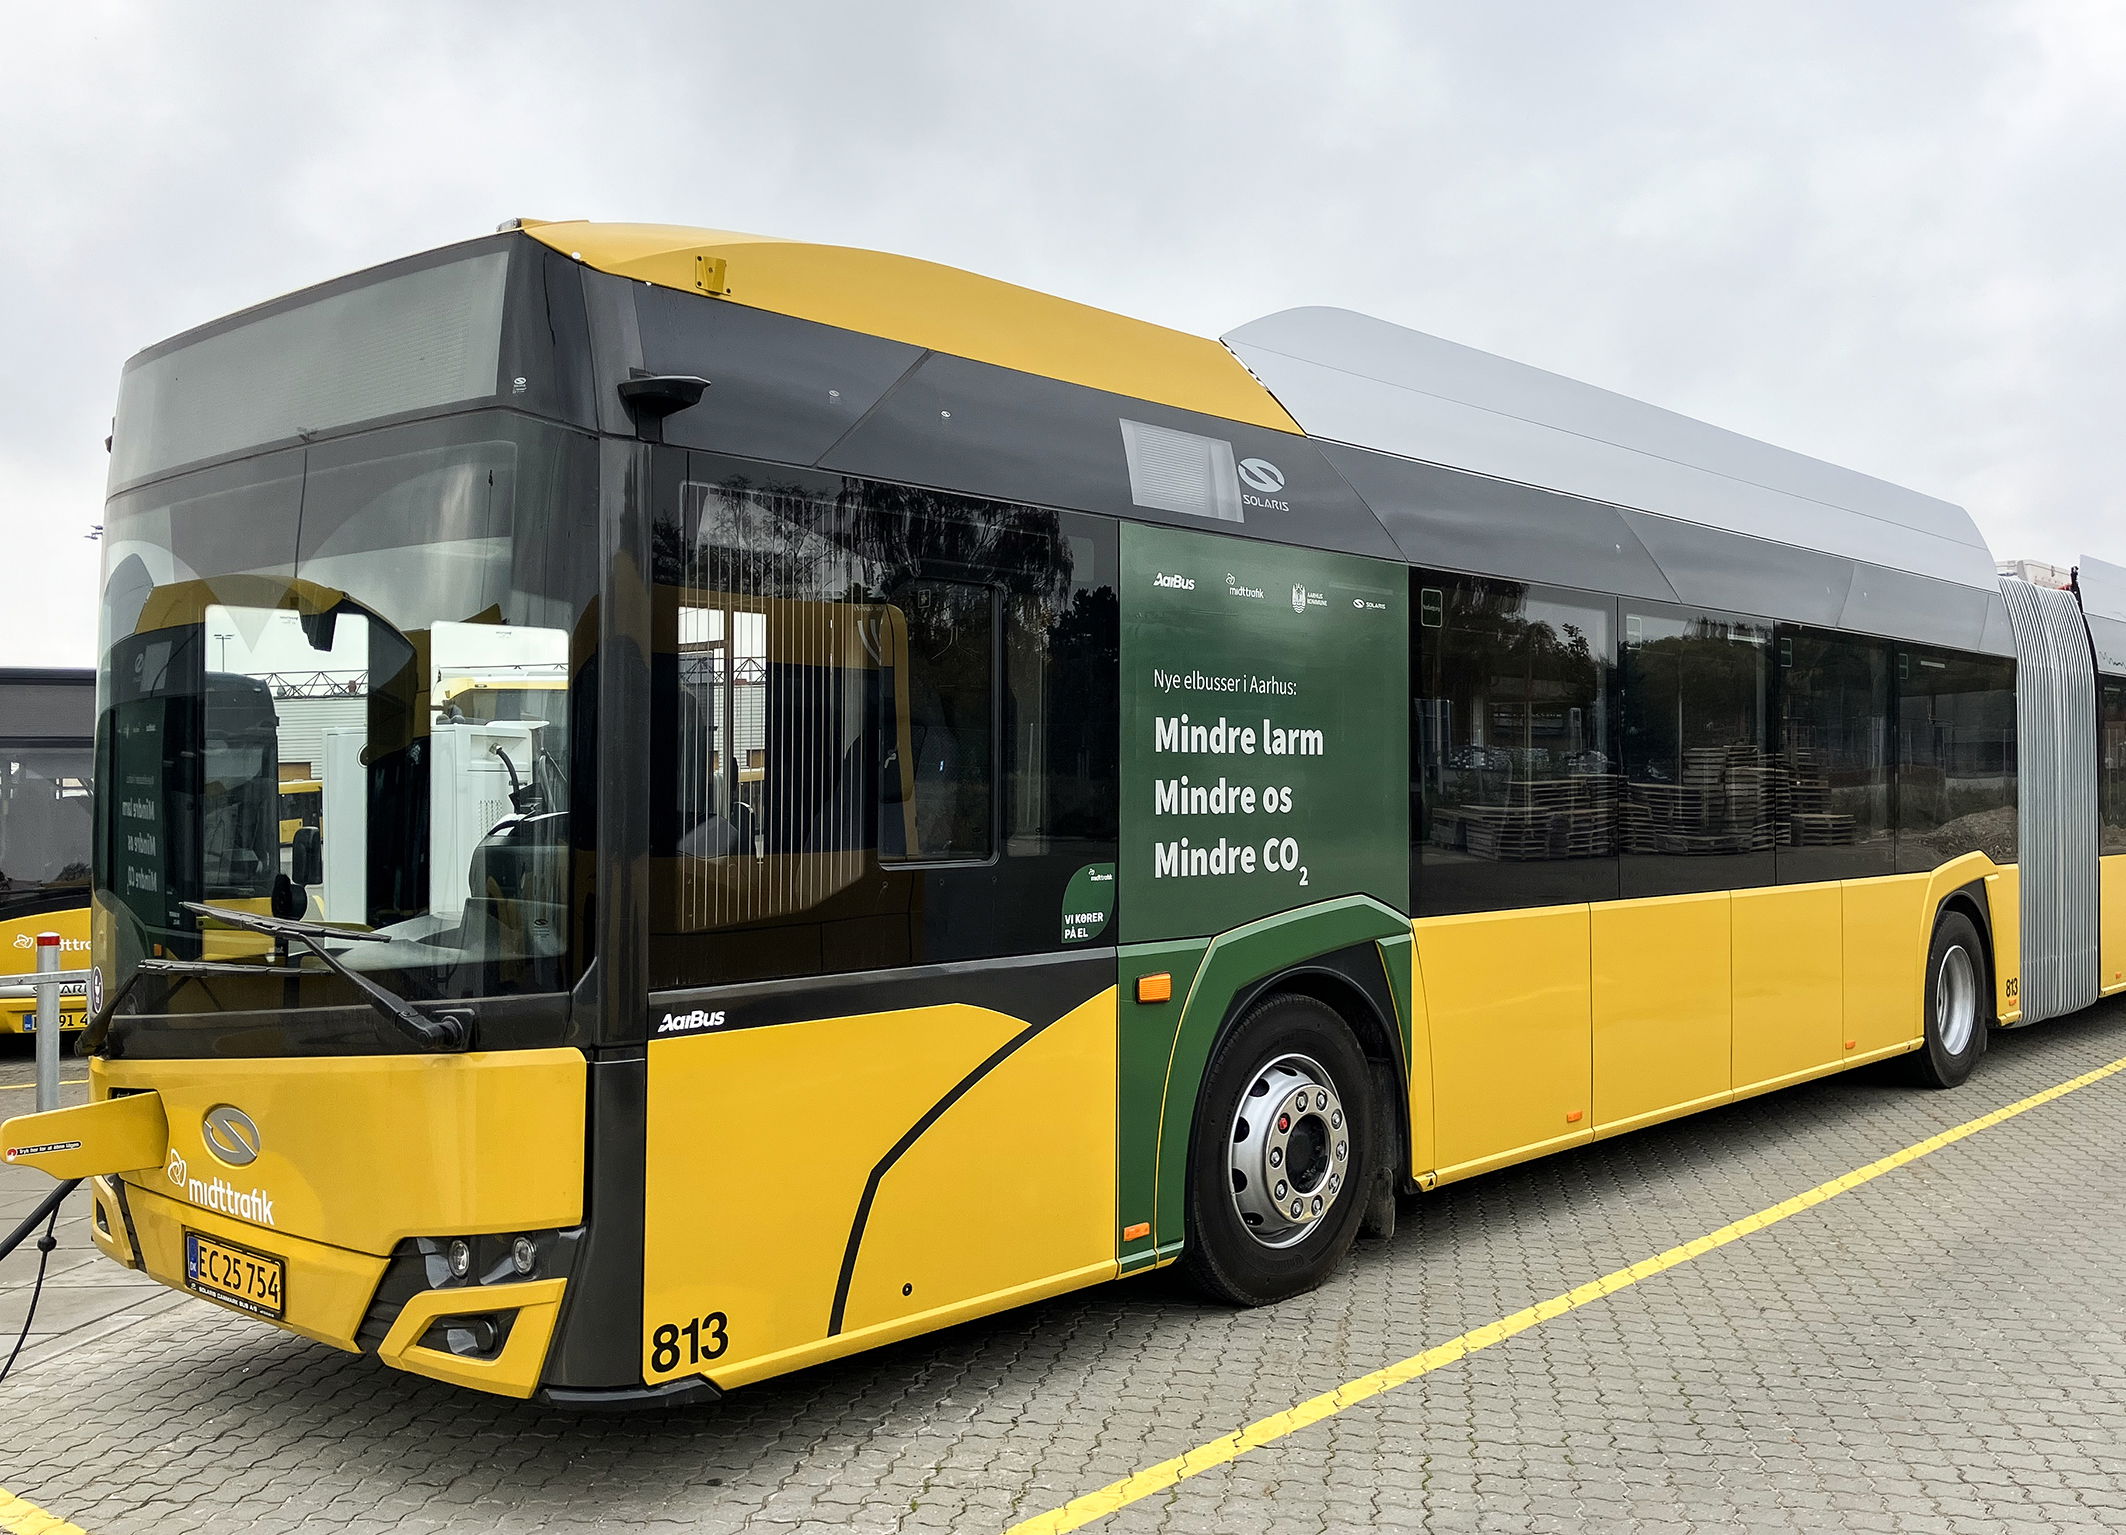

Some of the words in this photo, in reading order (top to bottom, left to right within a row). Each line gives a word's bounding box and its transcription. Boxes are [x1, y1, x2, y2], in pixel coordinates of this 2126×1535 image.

[1243, 494, 1290, 511] SOLARIS
[1153, 572, 1195, 590] AarBus
[1229, 586, 1264, 599] midttrafik
[1366, 601, 1386, 609] SOLARIS
[1154, 669, 1181, 693] Nye
[1183, 670, 1241, 692] elbusser
[1243, 674, 1247, 693] i
[1249, 675, 1297, 696] Aarhus:
[1155, 713, 1256, 754] Mindre
[1263, 719, 1324, 755] larm
[1155, 775, 1256, 815] Mindre
[1262, 786, 1293, 814] os
[1155, 837, 1256, 878] Mindre
[1064, 914, 1074, 924] VI
[1075, 912, 1104, 924] KØRER
[1064, 926, 1077, 939] PÅ
[1078, 928, 1088, 938] EL
[2006, 977, 2018, 997] 813
[658, 1010, 726, 1032] AarBus
[188, 1176, 275, 1225] midttrafik
[199, 1245, 219, 1283] EC
[223, 1254, 242, 1290] 25
[246, 1261, 279, 1304] 754
[651, 1311, 729, 1373] 813
